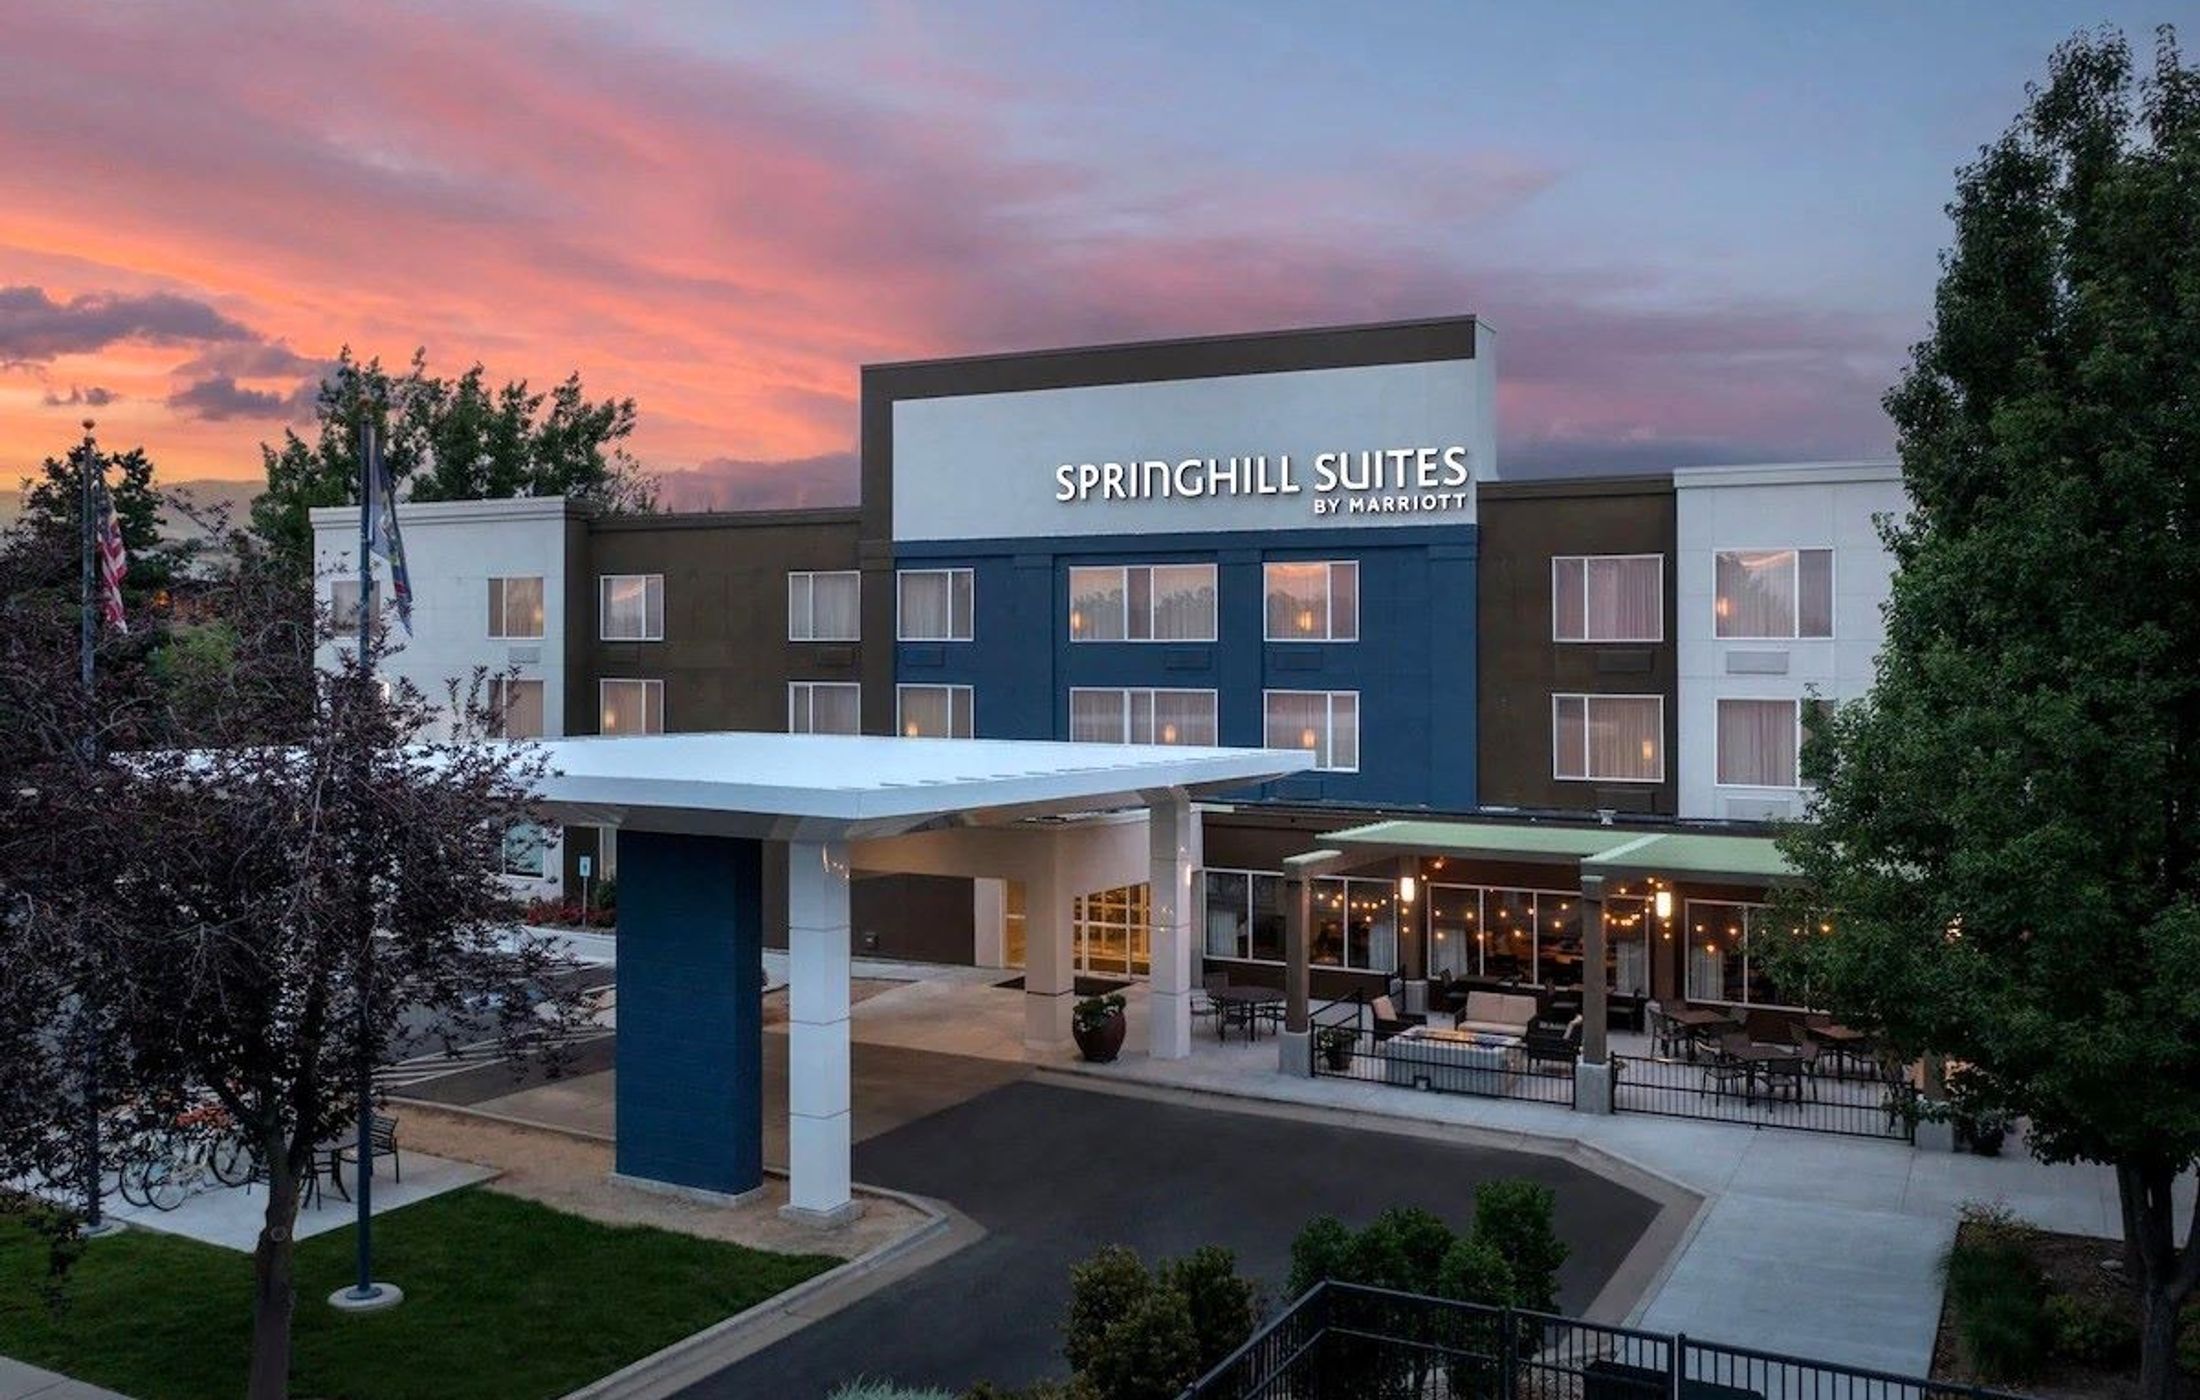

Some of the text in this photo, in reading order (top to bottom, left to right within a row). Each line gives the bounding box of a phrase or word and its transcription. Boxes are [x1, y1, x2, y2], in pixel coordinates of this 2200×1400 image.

[1055, 446, 1468, 501] SPRINGHILL SUITES
[1313, 493, 1467, 514] BY MARRIOTT
